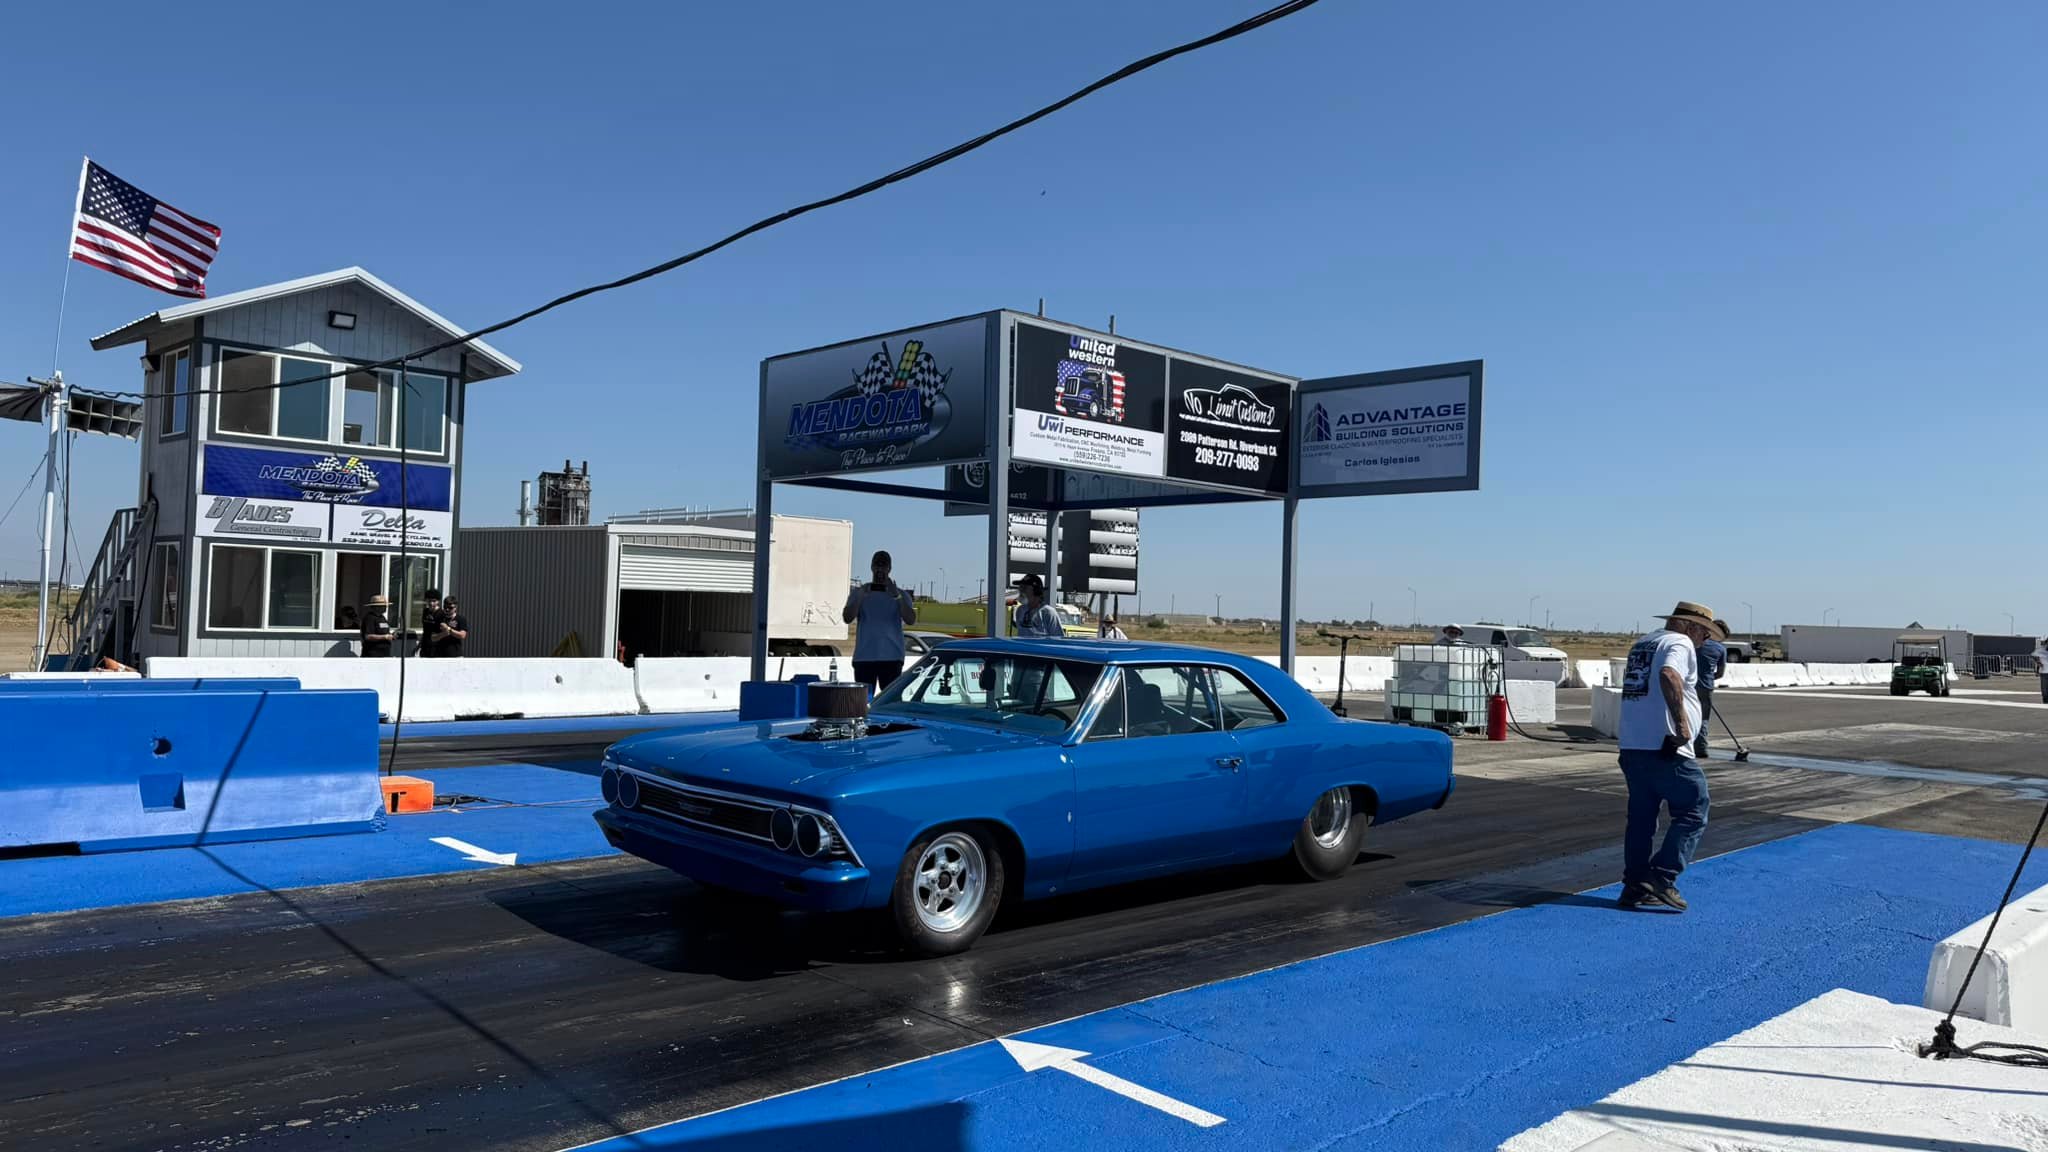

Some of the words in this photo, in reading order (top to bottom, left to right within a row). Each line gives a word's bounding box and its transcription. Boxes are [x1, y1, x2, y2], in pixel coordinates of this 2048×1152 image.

[1070, 335, 1116, 357] United
[1068, 348, 1115, 367] western
[787, 388, 921, 438] MENDOTA
[1336, 402, 1467, 427] ADVANTAGE
[838, 426, 891, 442] RACEWAY
[894, 422, 928, 435] PARK
[1065, 426, 1145, 448] PERFORMANCE
[1336, 428, 1387, 441] BUILDING
[1391, 422, 1465, 438] SOLUTIONS
[1195, 447, 1260, 472] 209-277-0093
[1344, 458, 1378, 468] Carlos
[1380, 456, 1421, 467] Iglesias
[258, 465, 361, 486] MENDOTA
[205, 496, 294, 532] BLADES
[361, 509, 426, 530] Delta
[231, 524, 261, 533] General
[263, 526, 308, 537] Contracting
